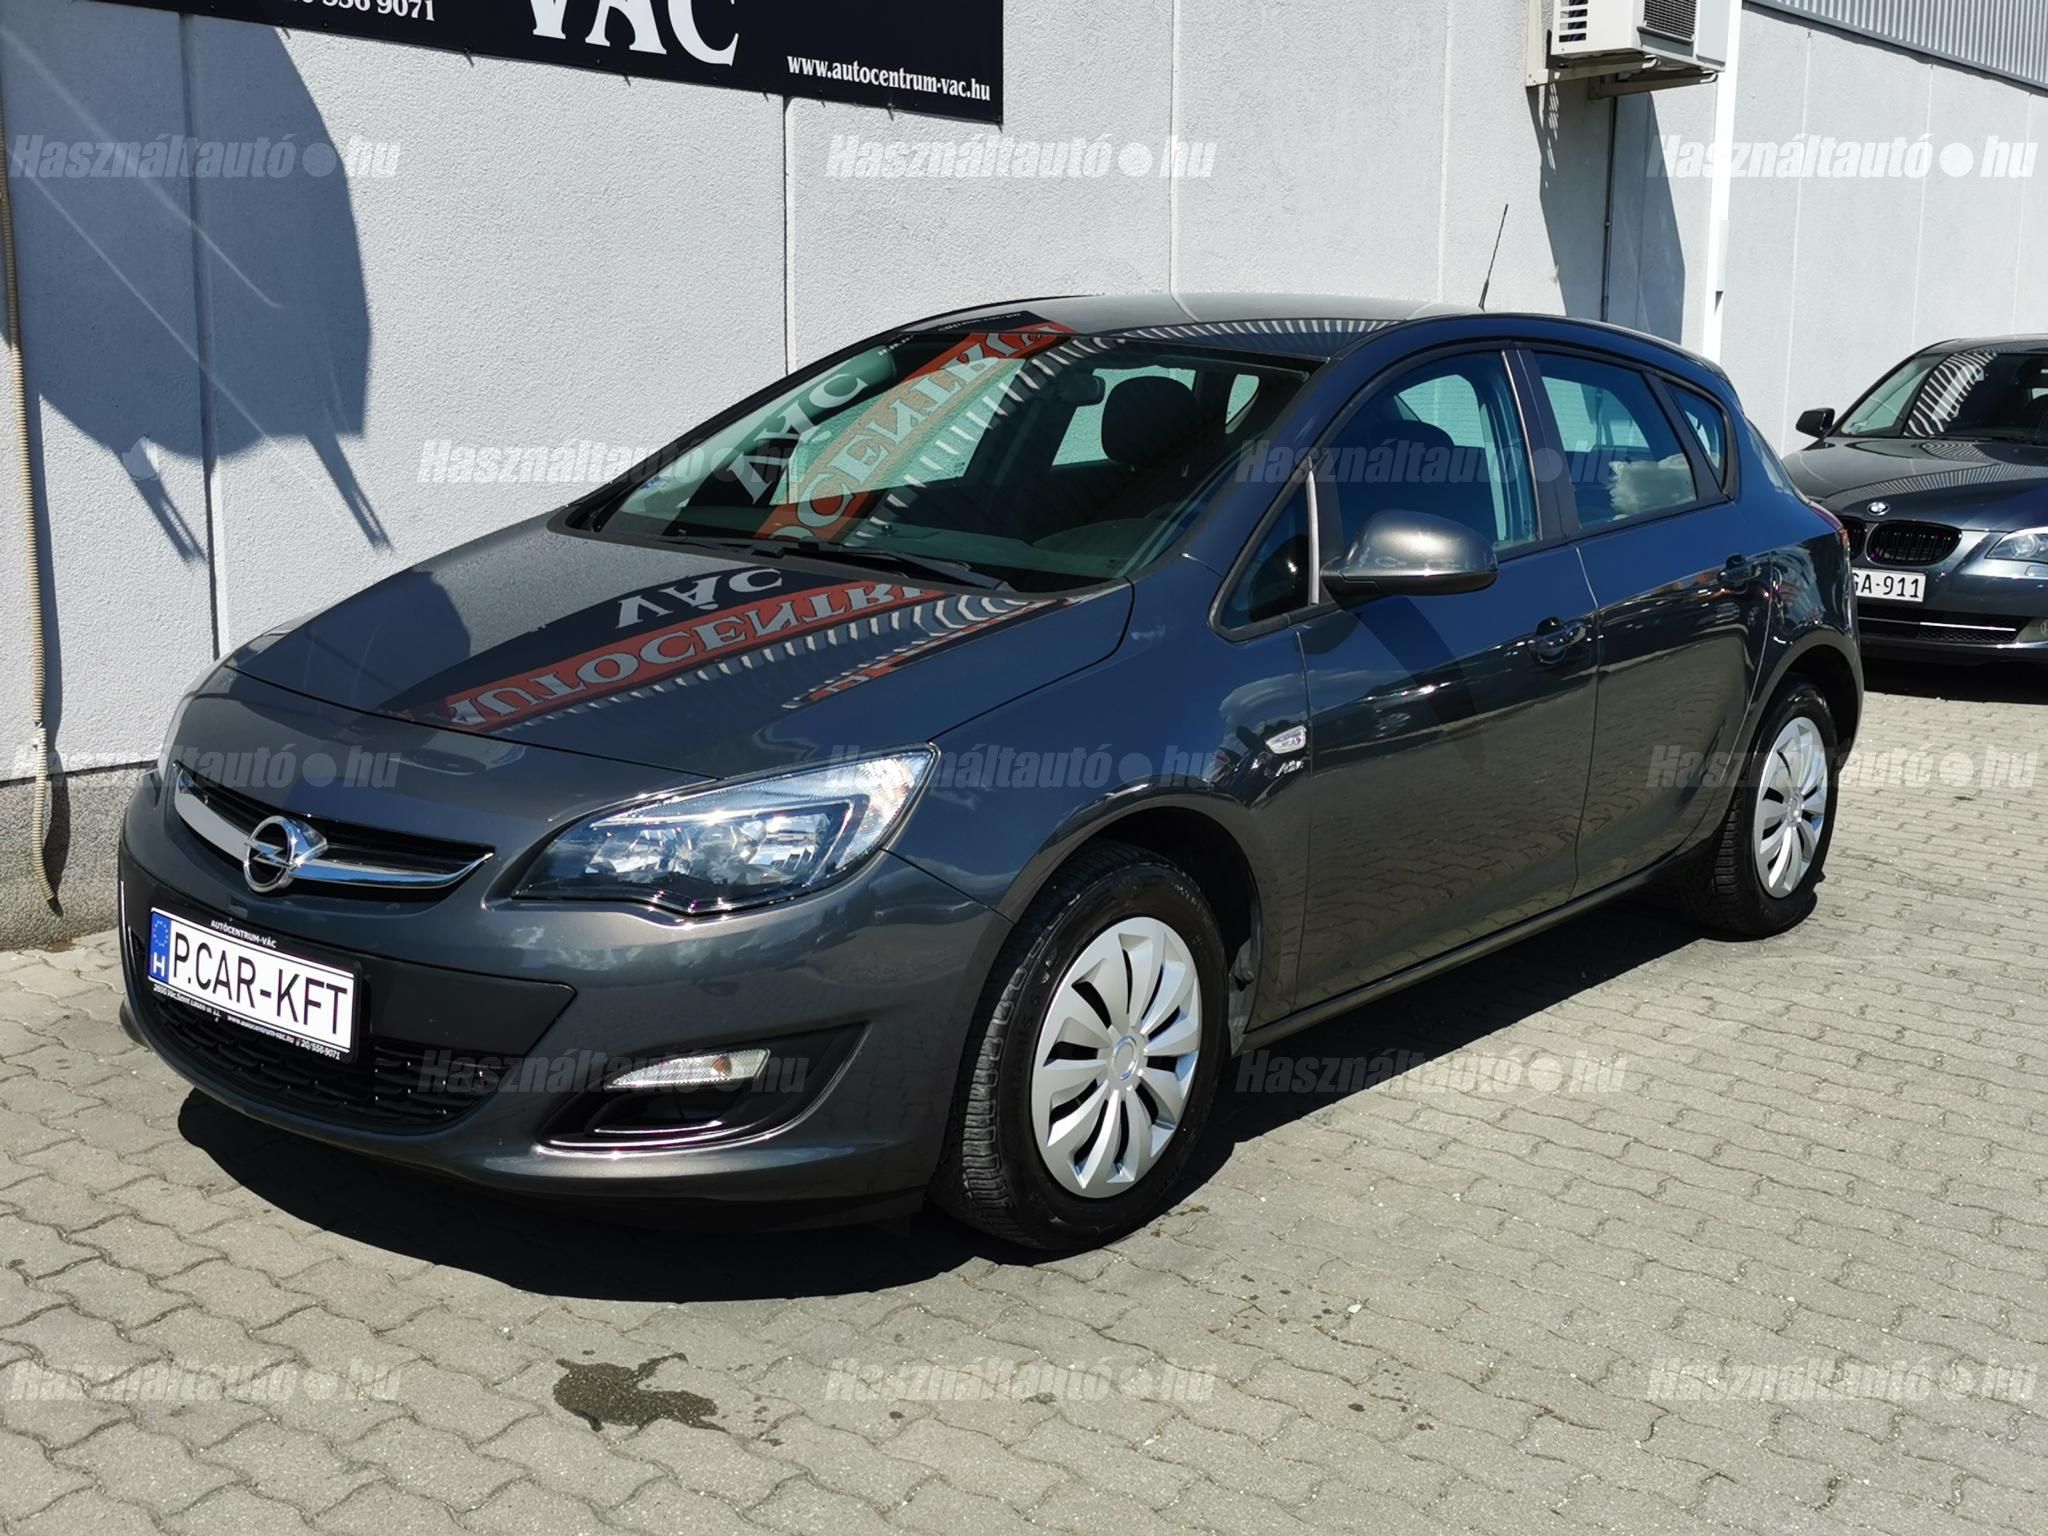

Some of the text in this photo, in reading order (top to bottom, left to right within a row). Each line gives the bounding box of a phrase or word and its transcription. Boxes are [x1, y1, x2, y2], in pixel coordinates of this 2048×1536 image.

[787, 55, 990, 101] www.autocentrum-vac.hu
[153, 952, 165, 977] H
[174, 932, 347, 1034] P.CAR-KFT
